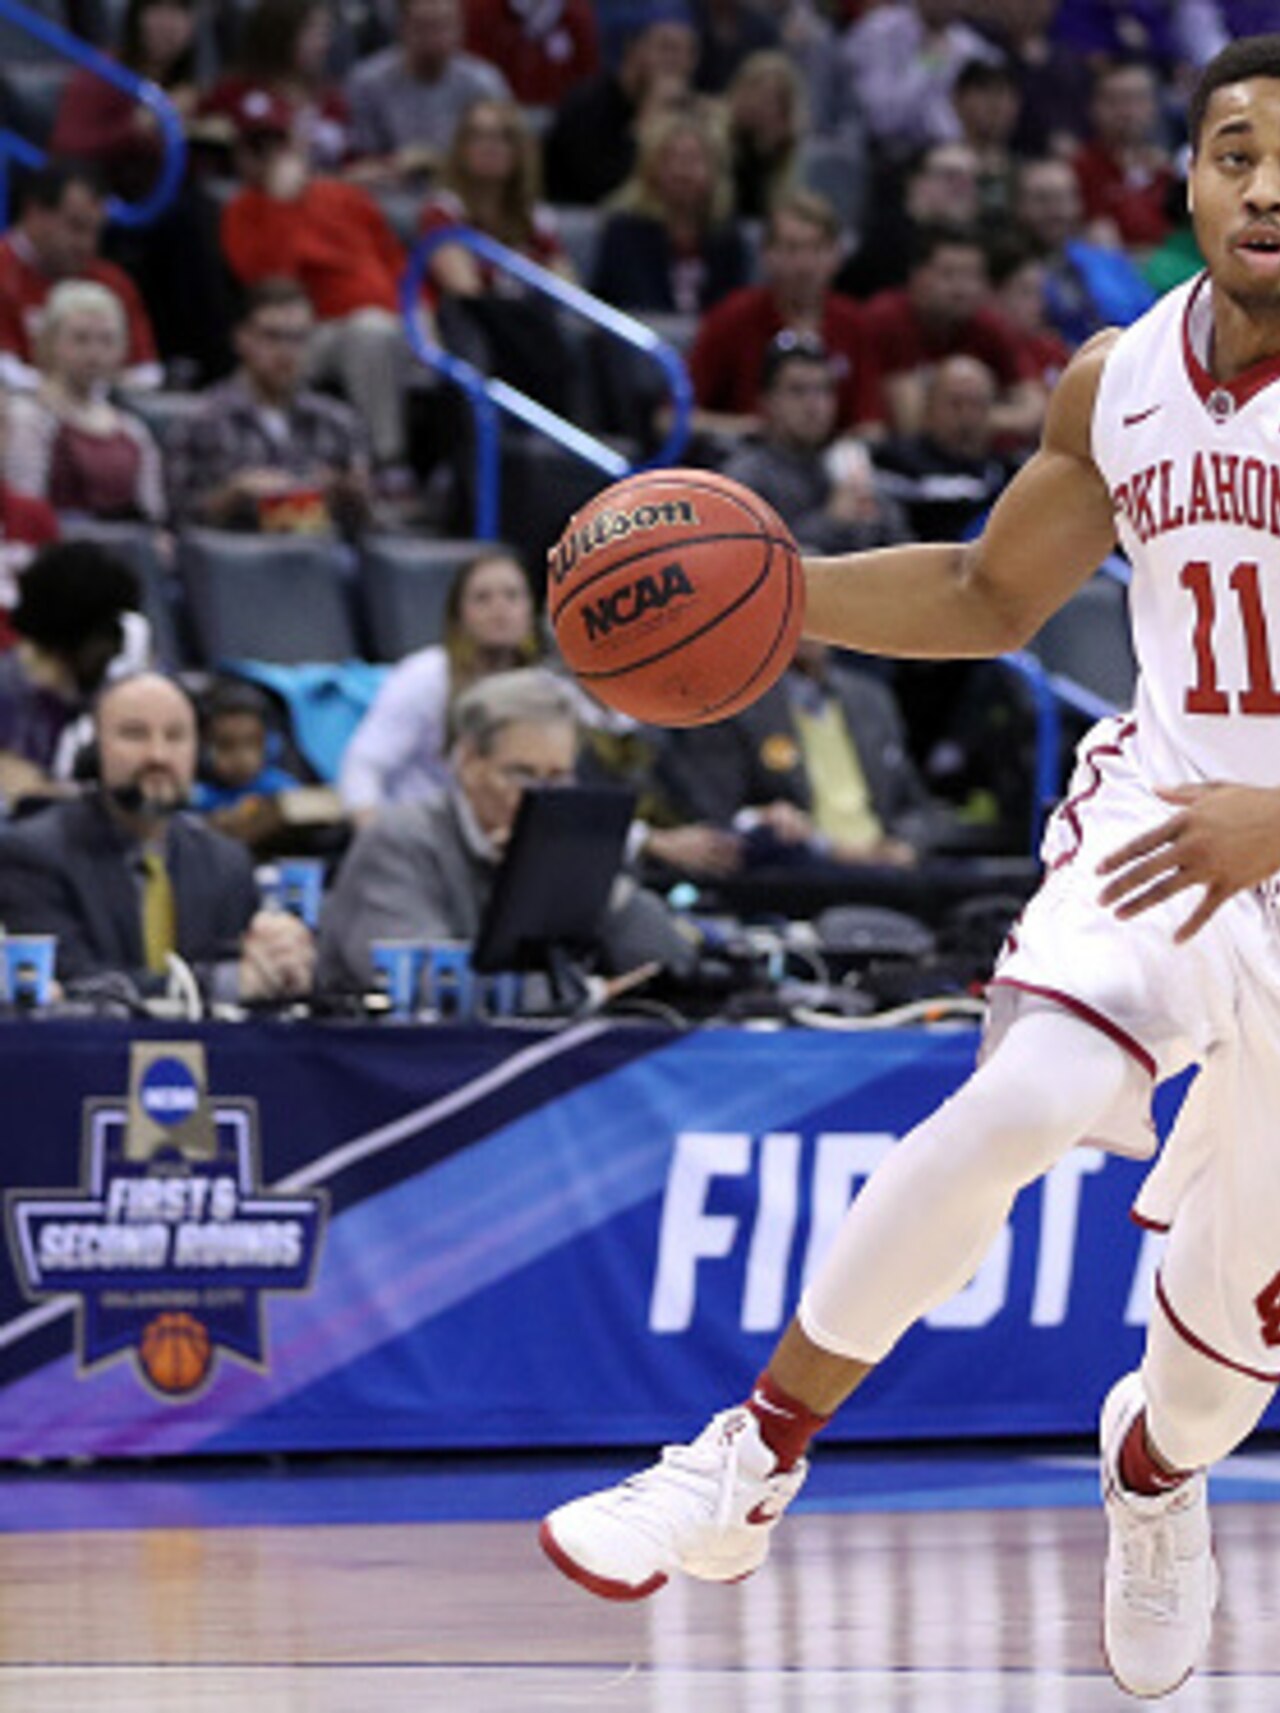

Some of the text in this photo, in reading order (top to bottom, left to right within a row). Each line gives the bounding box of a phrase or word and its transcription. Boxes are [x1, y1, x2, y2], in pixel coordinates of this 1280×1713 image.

[548, 499, 699, 584] Wilson
[580, 562, 695, 642] NCAA
[107, 1176, 208, 1223] FIRST
[39, 1219, 303, 1270] SECOND ROUNDS
